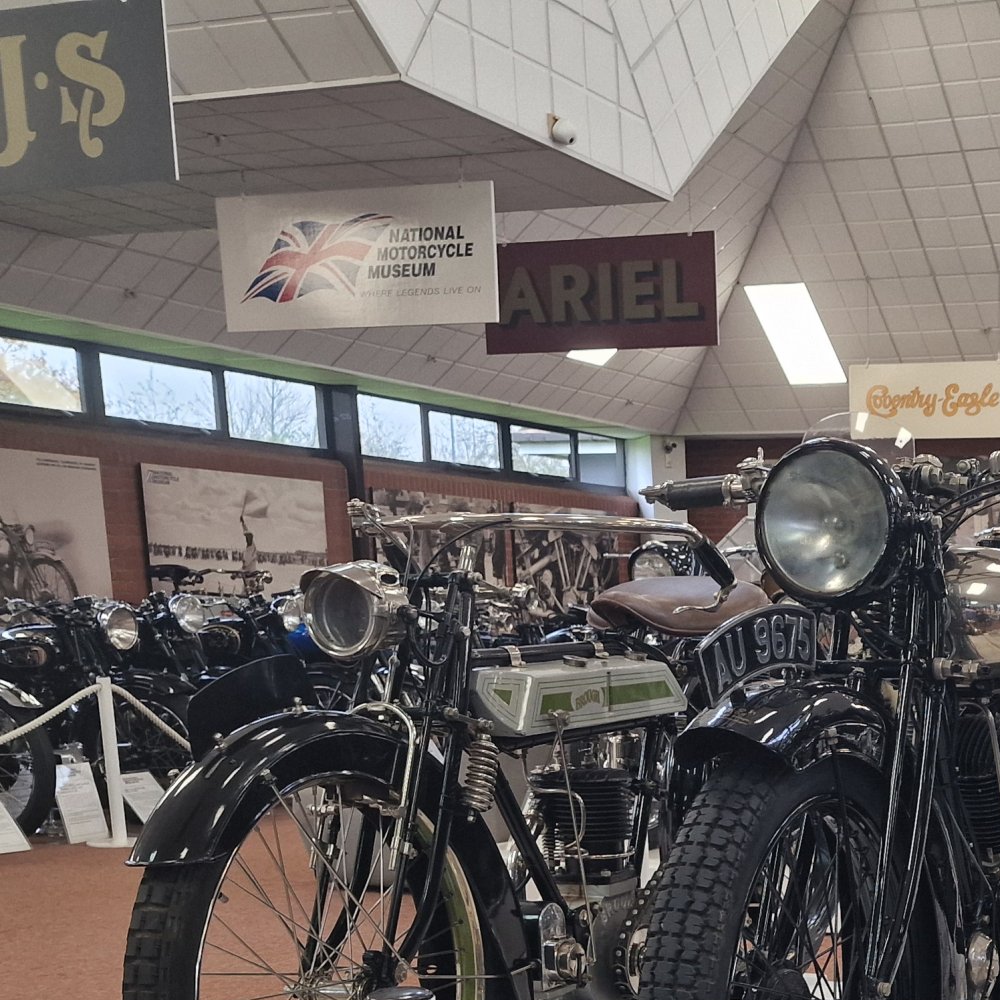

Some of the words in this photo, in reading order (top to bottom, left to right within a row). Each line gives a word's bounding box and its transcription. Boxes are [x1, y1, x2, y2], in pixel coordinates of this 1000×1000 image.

[388, 225, 465, 243] NATIONAL
[377, 242, 474, 261] MOTORCYCLE
[368, 262, 436, 279] MUSEUM
[396, 287, 439, 297] LEGENDS
[443, 287, 463, 295] LIVE
[466, 285, 481, 294] ON
[500, 258, 704, 328] ARIEL
[866, 383, 1000, 418] Coventry-Eagle
[713, 626, 747, 694] AU
[754, 614, 811, 664] 9675
